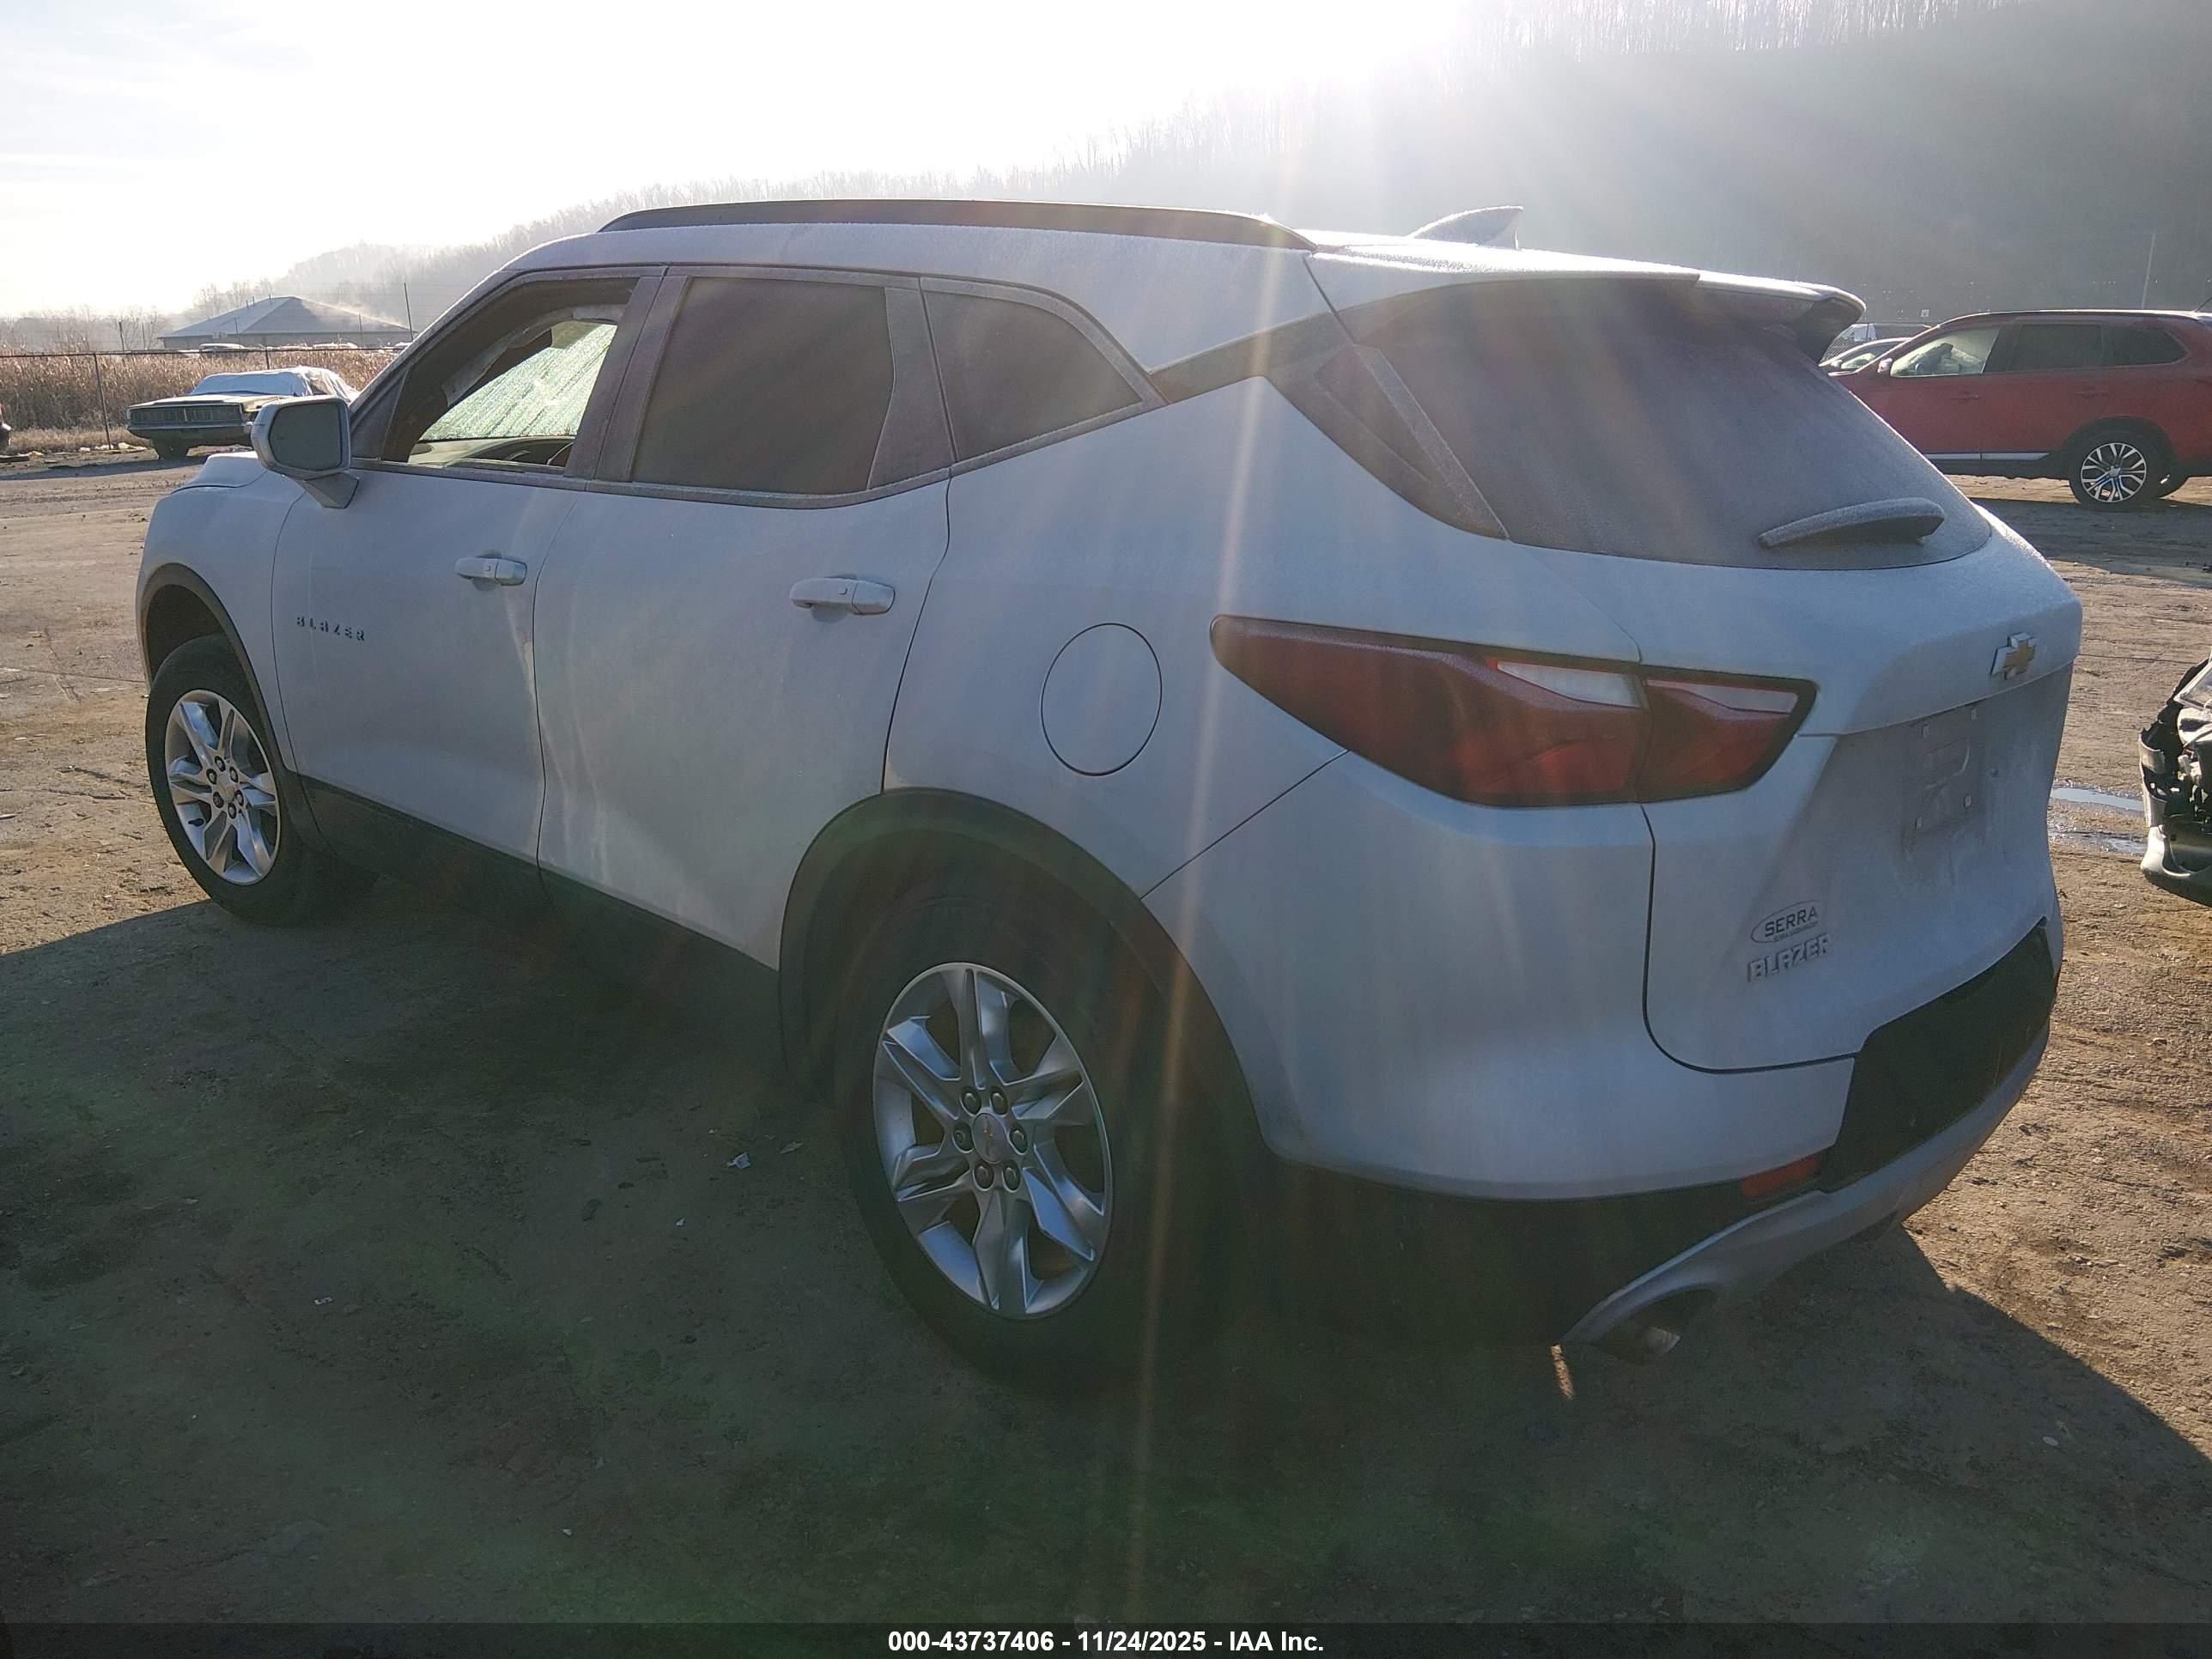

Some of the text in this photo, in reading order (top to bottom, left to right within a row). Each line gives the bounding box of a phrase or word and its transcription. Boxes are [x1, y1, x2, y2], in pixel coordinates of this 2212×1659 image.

[296, 615, 365, 642] BLAZER
[1764, 906, 1819, 938] SERRA
[1747, 932, 1832, 982] BLAZER
